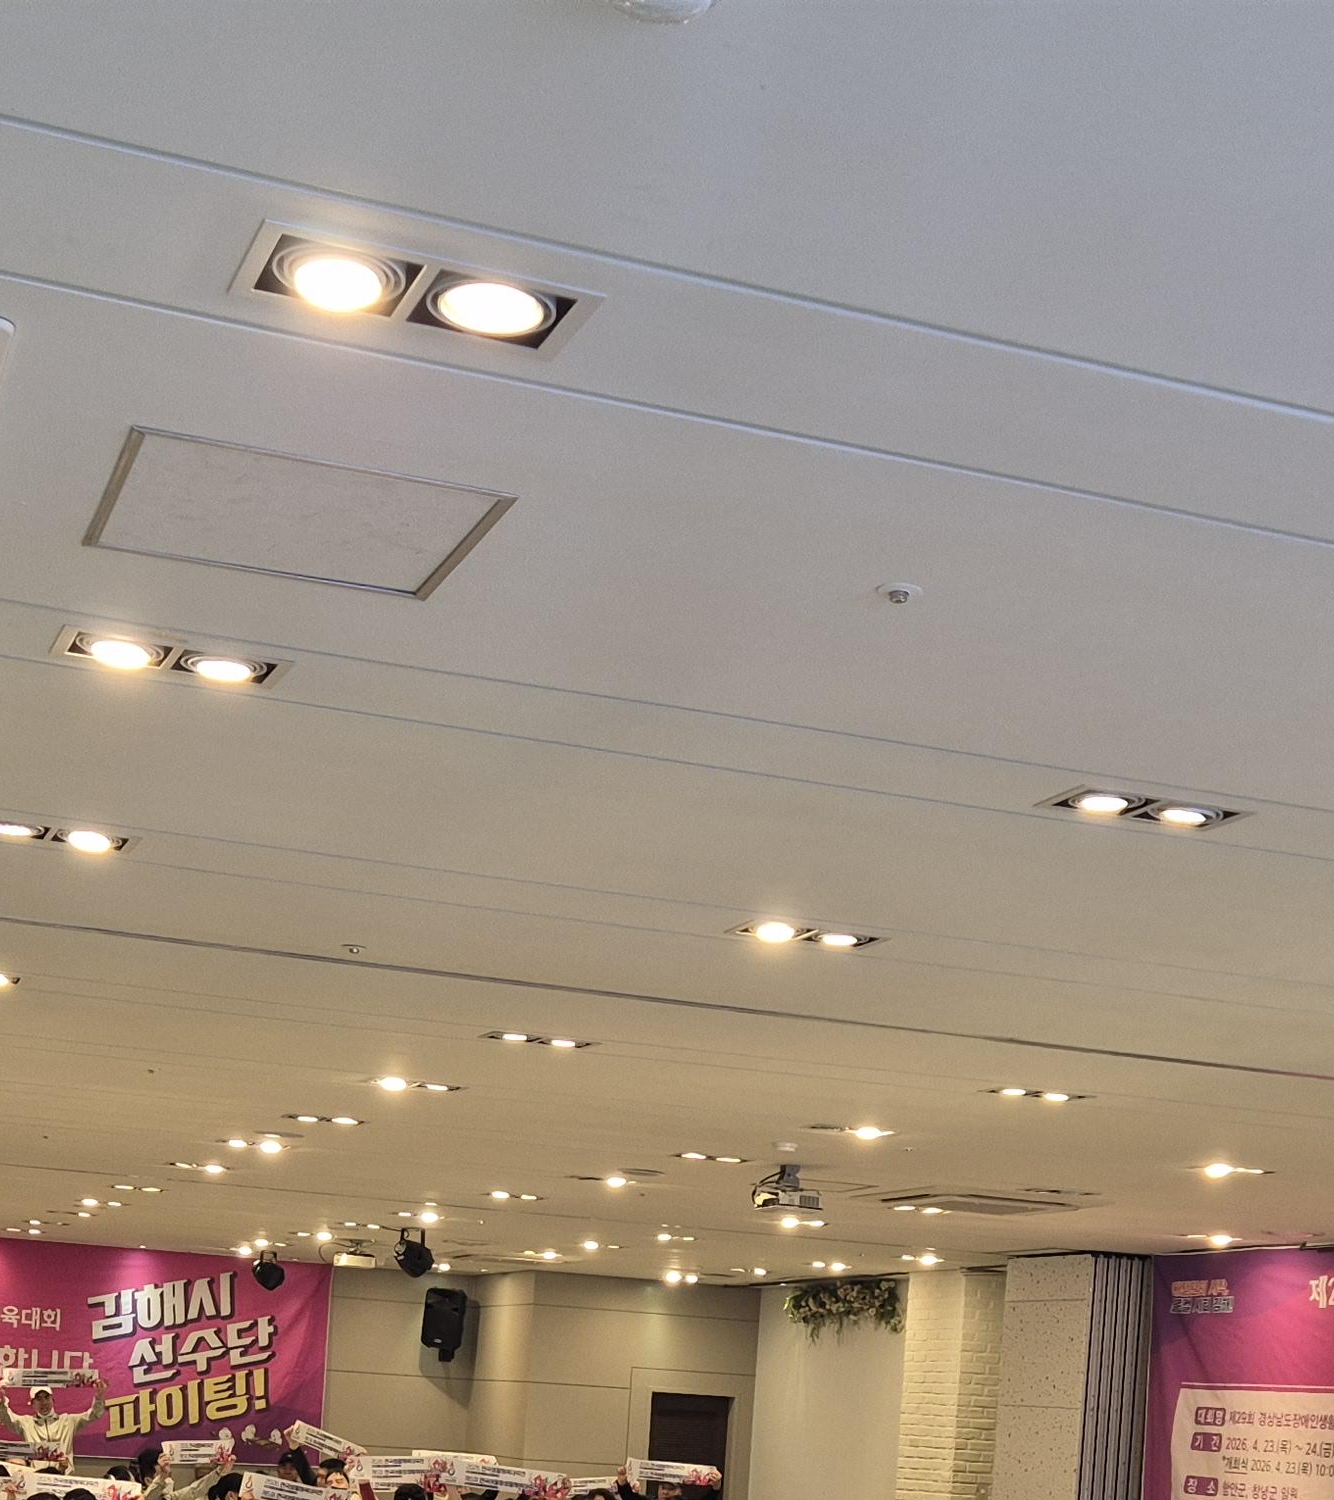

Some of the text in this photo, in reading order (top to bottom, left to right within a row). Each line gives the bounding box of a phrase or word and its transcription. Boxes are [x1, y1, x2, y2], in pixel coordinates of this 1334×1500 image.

[88, 1272, 235, 1340] 김해시
[129, 1316, 275, 1384] 선수단
[104, 1368, 267, 1438] 파이팅!
